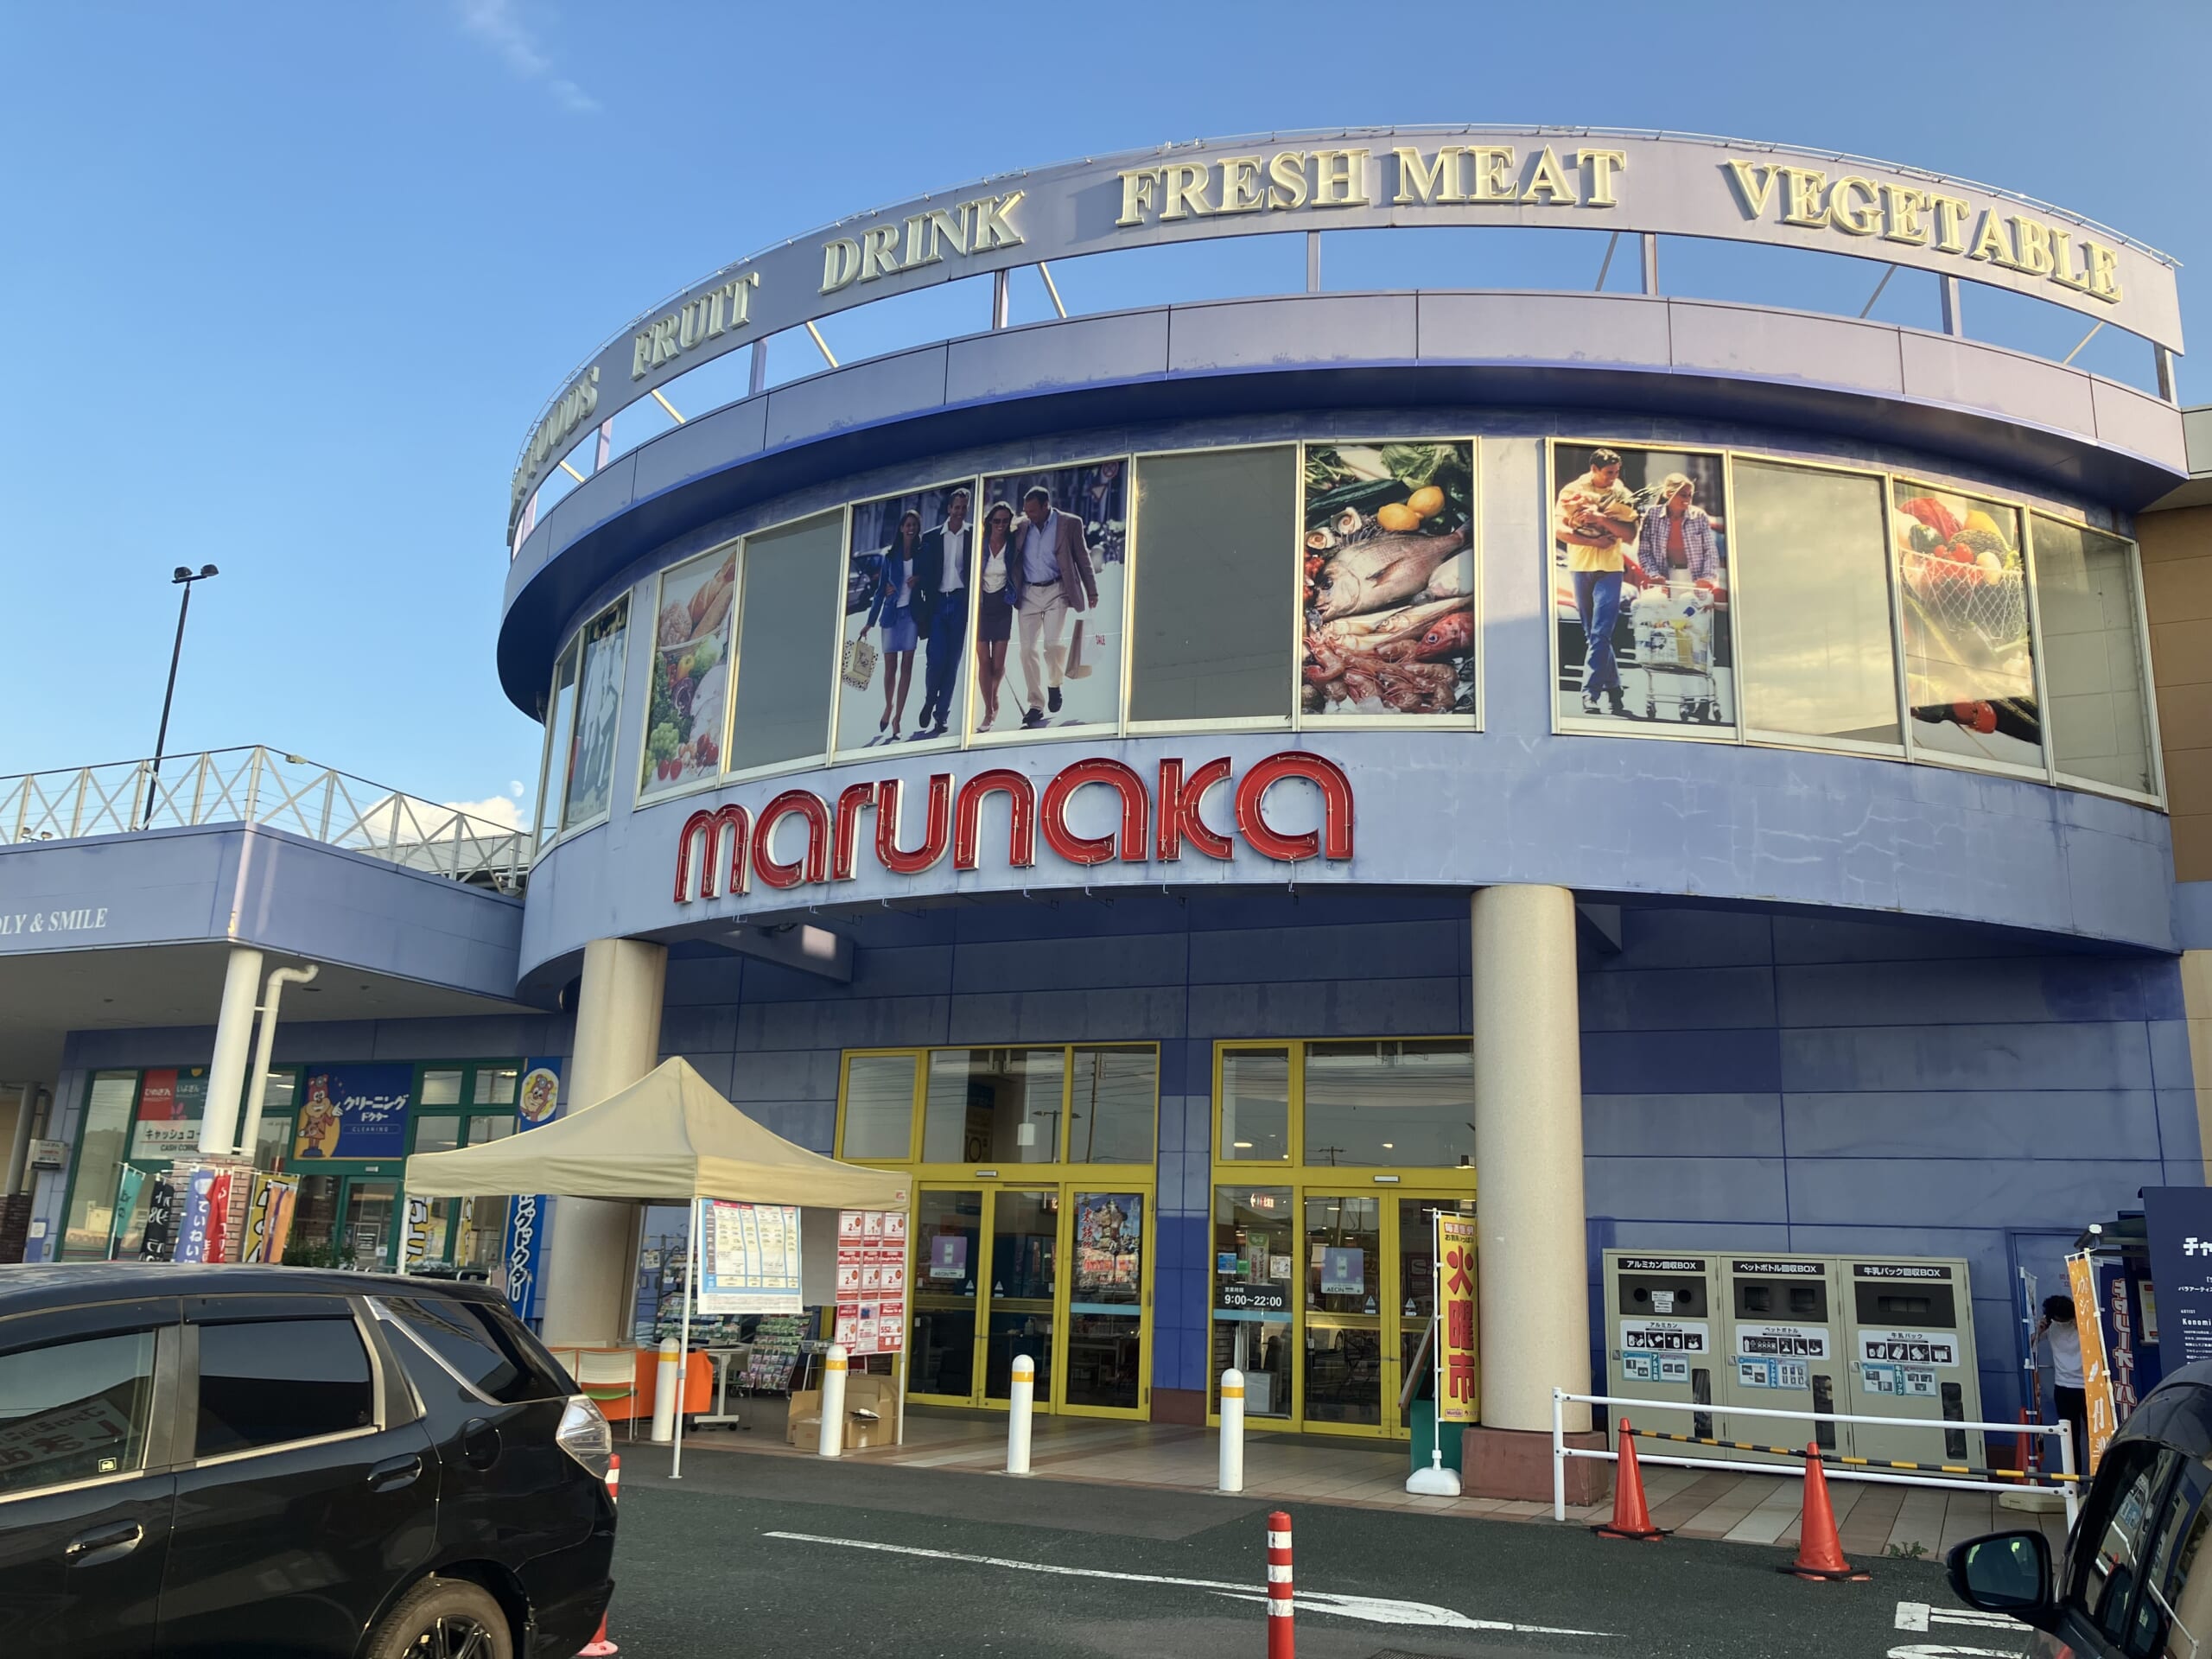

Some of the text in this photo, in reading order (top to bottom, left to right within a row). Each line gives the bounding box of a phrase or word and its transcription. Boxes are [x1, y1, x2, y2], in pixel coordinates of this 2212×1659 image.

[1116, 144, 1626, 227] FRESH MEAT
[817, 189, 1027, 295] DRINK
[1727, 158, 2123, 305] VEGETABLE
[629, 271, 759, 381] FRUIT
[673, 750, 1354, 905] marunaka
[0, 907, 108, 935] LY & SMILE
[344, 1093, 410, 1111] クリーニング
[361, 1111, 389, 1122] ドクター
[184, 1200, 210, 1263] ていねい
[1626, 1260, 1697, 1270] アルミカン回収BOX
[1740, 1263, 1817, 1273] ペットボトル回収BOX
[1864, 1267, 1942, 1277] 牛乳パック回収BOX
[1446, 1245, 1476, 1404] 火曜市
[2183, 1318, 2212, 1326] Konomi
